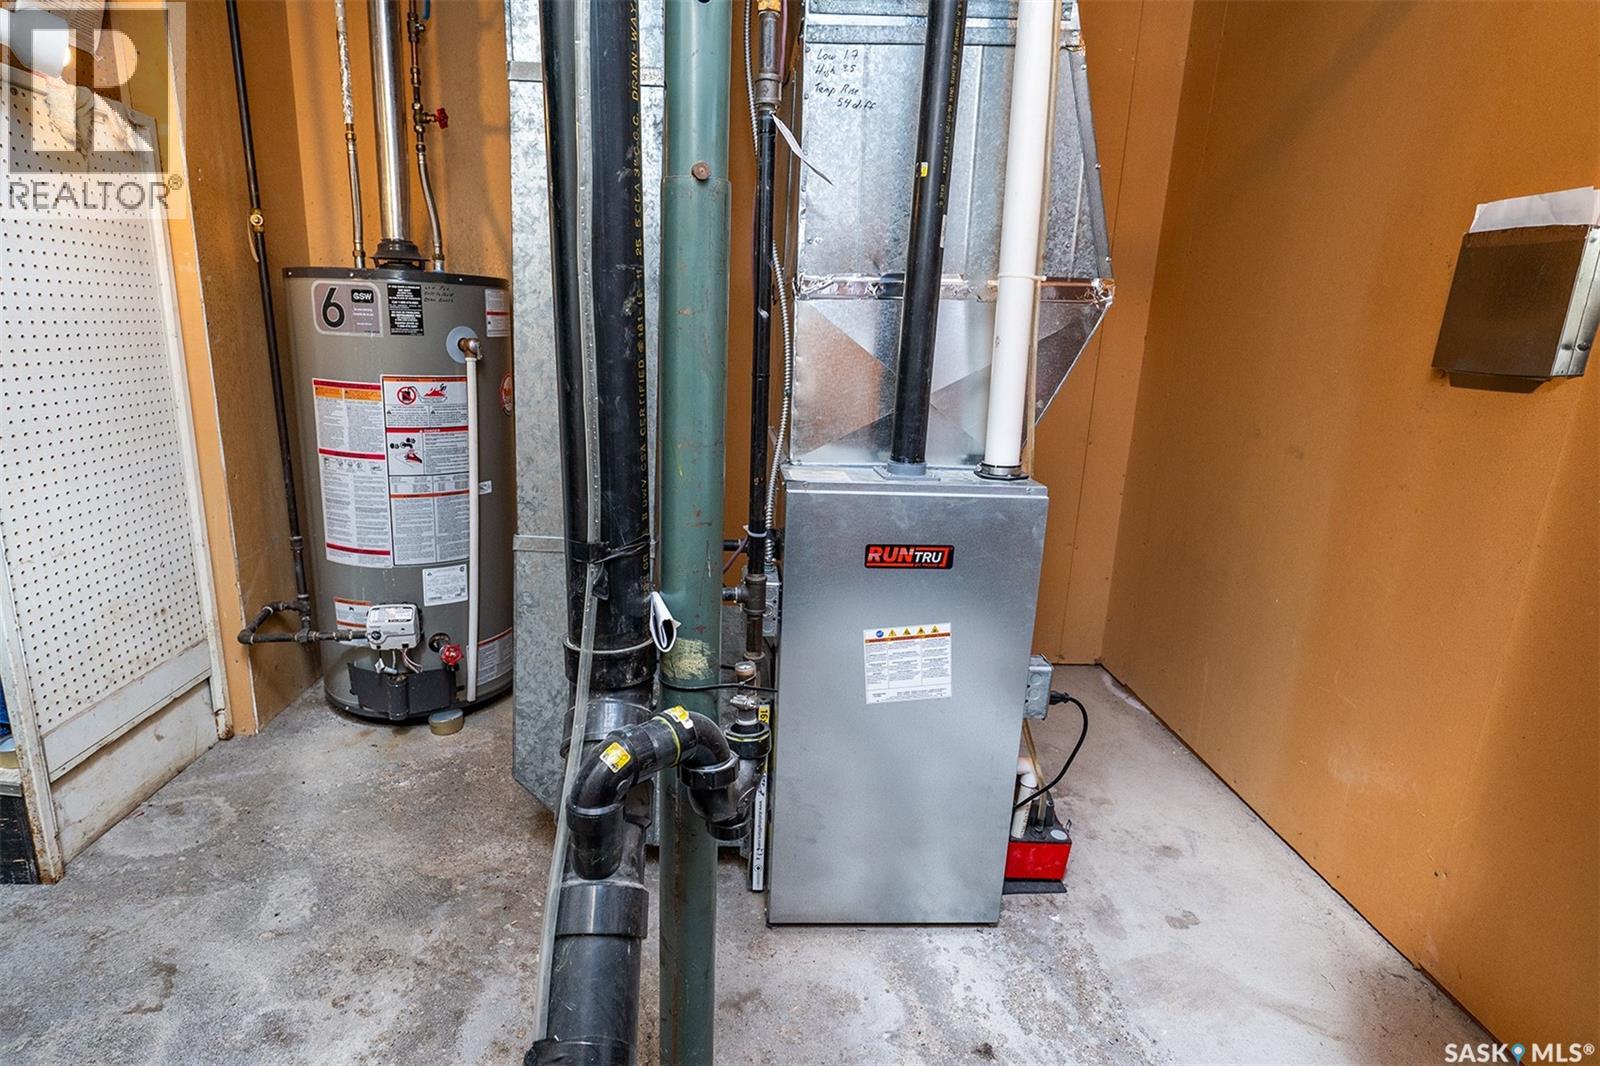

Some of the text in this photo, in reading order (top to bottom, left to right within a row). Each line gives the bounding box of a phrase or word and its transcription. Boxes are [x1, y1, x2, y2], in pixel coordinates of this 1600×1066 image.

[816, 48, 836, 60] Low
[814, 82, 836, 97] Temp
[352, 292, 373, 300] GSW
[321, 286, 346, 329] 6
